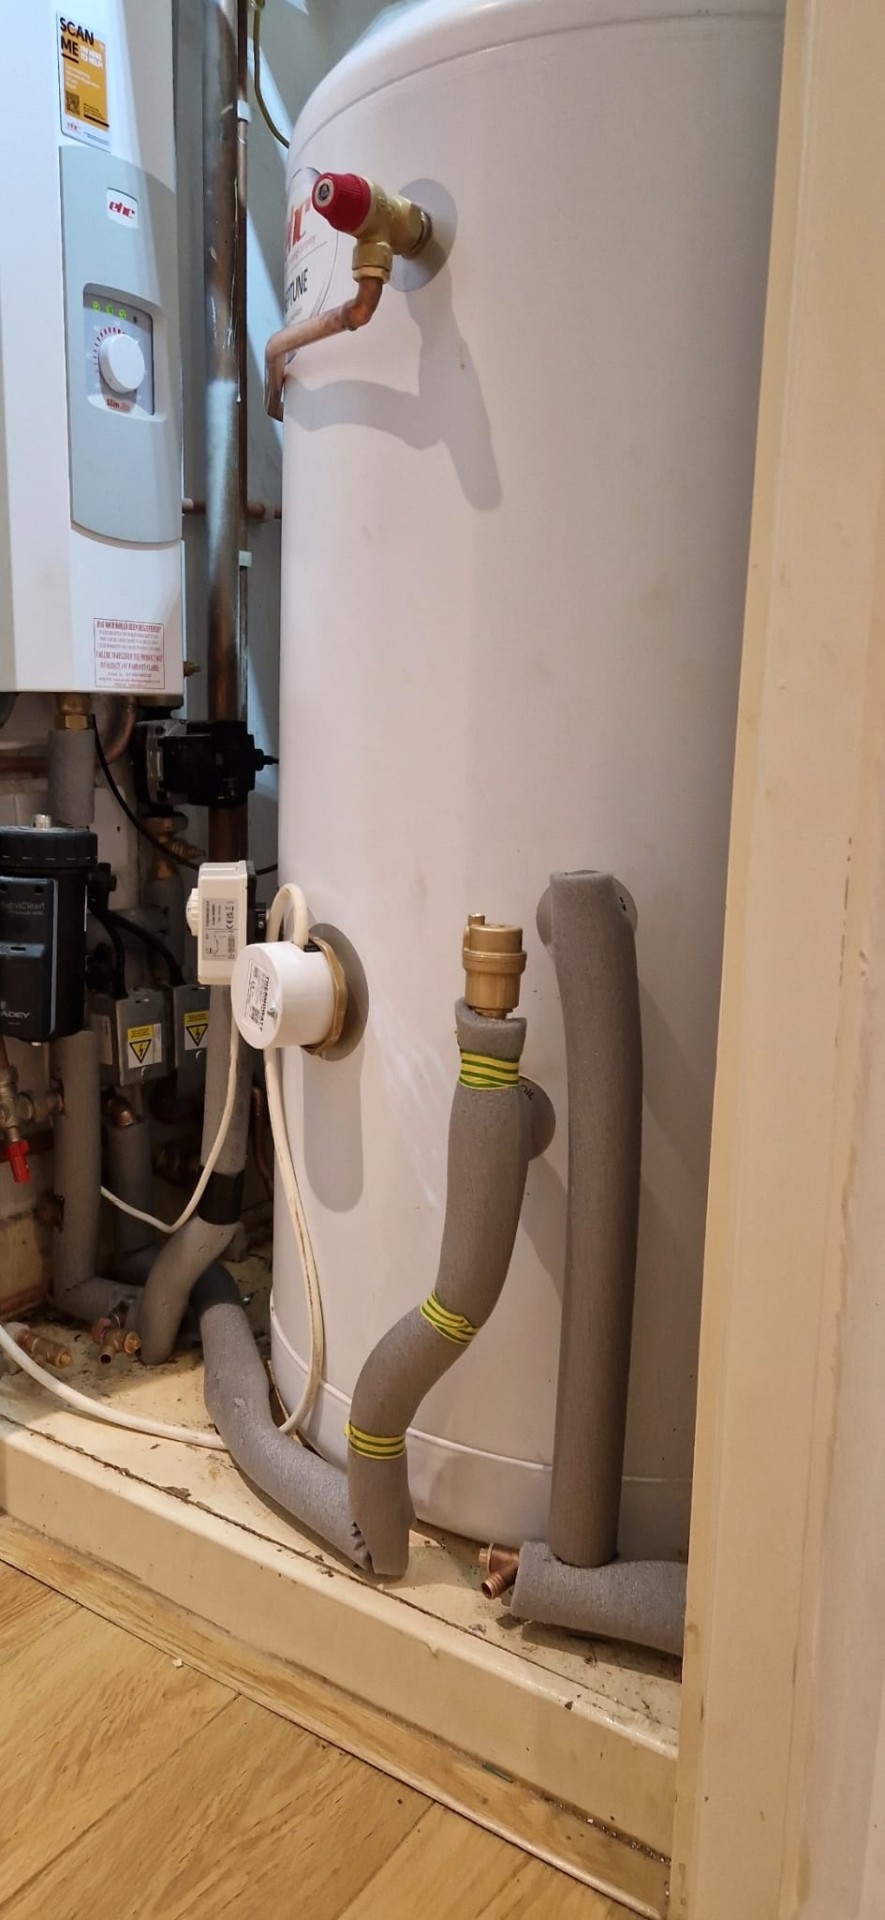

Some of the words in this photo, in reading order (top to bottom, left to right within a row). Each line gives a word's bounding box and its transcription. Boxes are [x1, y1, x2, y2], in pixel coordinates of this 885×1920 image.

[60, 17, 94, 46] SCAN
[60, 36, 79, 57] ME
[0, 1010, 32, 1019] ADEY
[259, 976, 269, 1032] THERMOWATT
